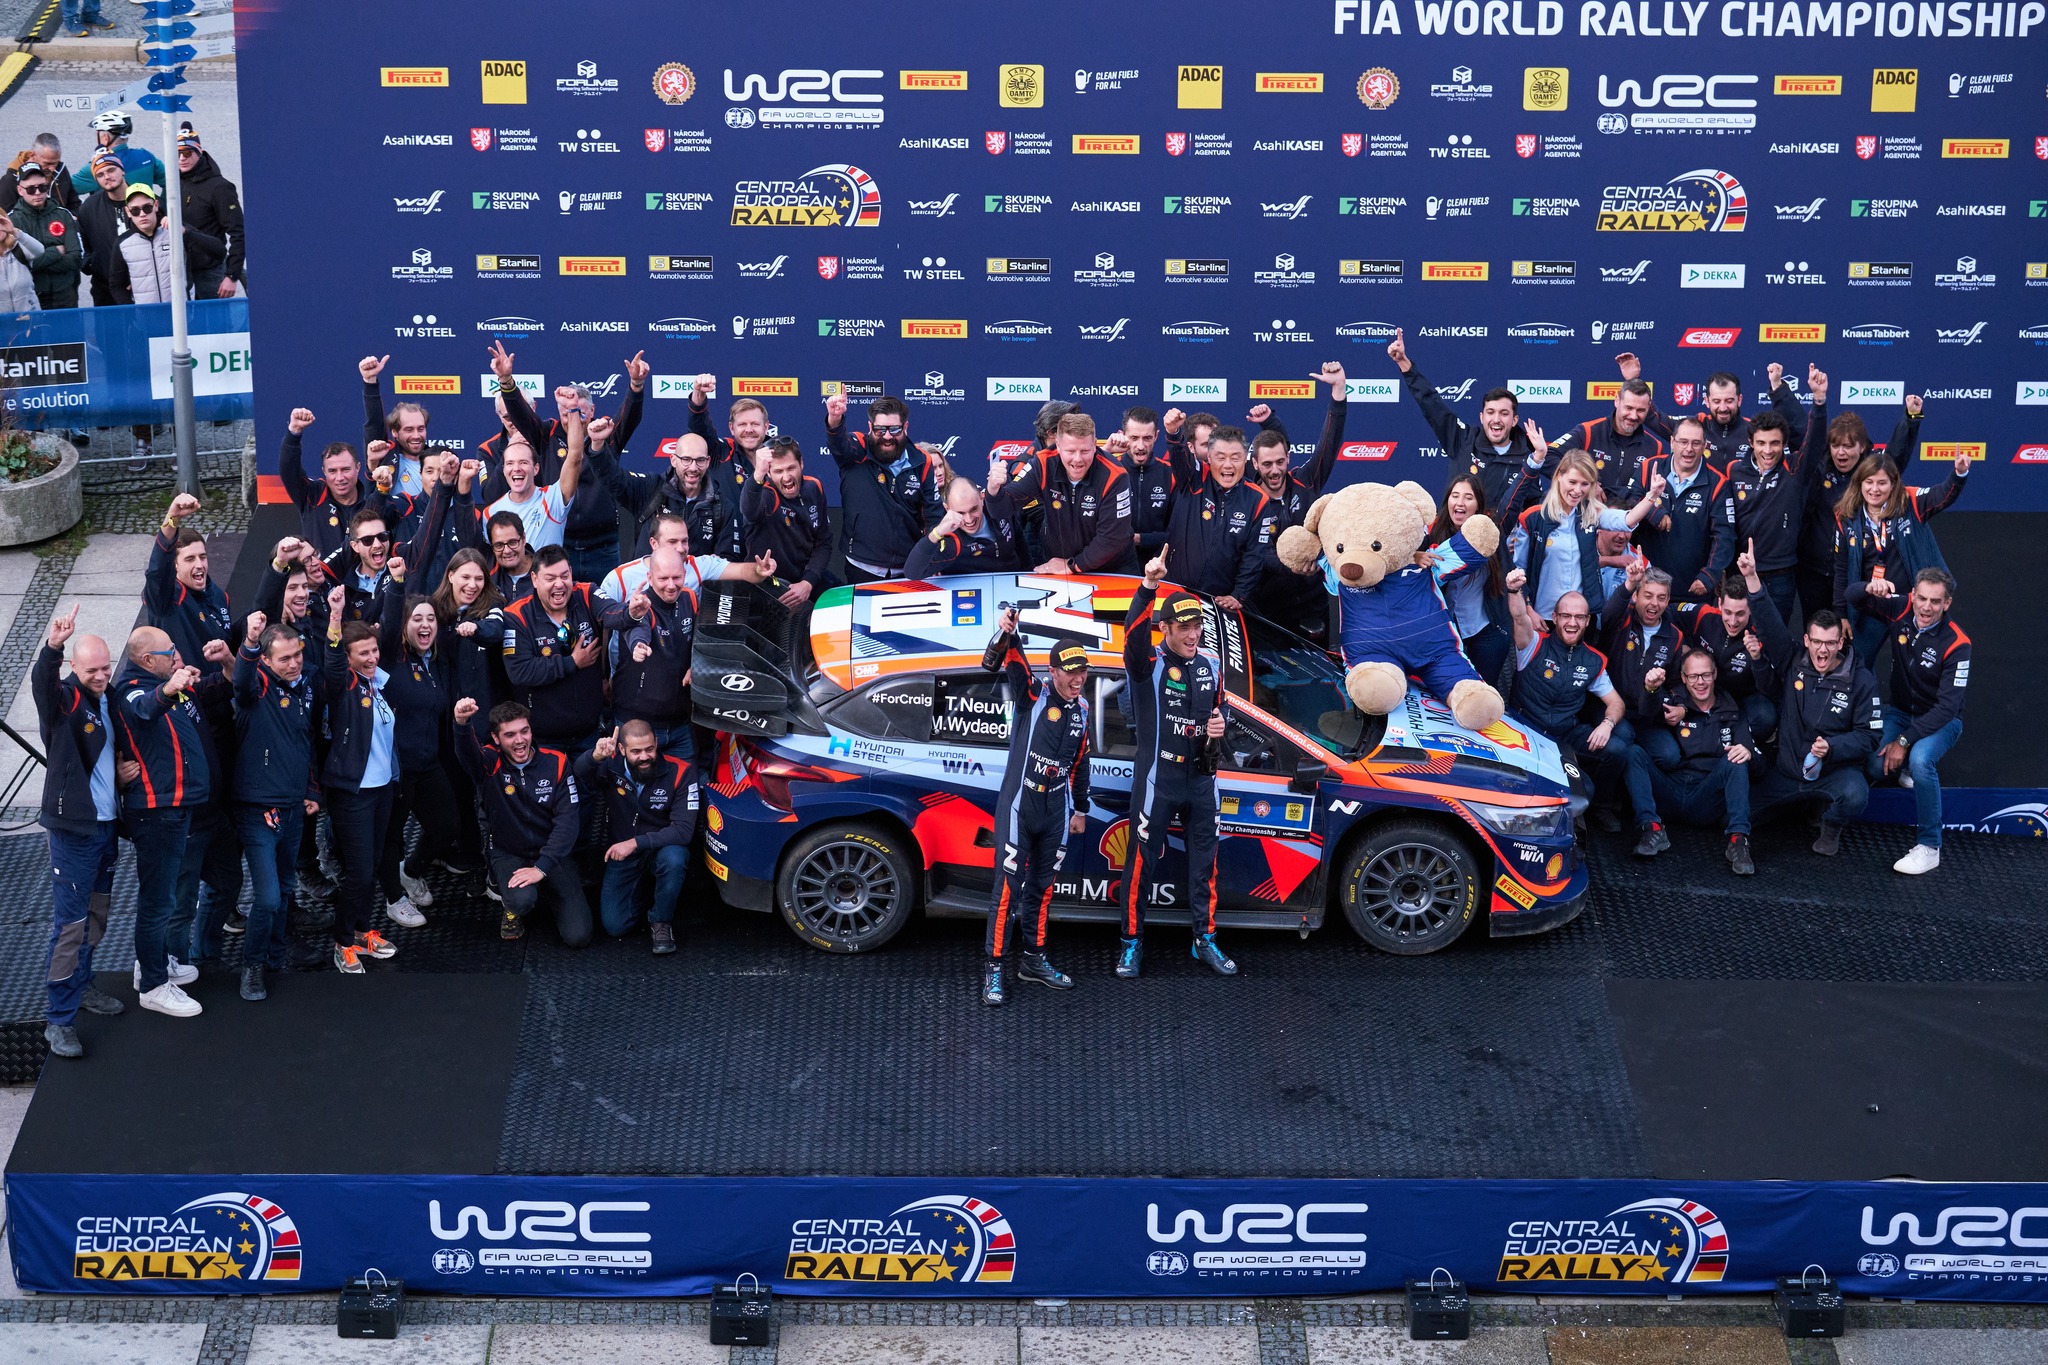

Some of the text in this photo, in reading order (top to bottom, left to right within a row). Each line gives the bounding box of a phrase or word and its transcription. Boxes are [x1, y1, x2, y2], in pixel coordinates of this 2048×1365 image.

[1334, 0, 2046, 38] FIA WORLD RALLY CHAMPIONSHIP
[484, 63, 523, 76] ADAC
[1181, 68, 1220, 81] ADAC
[388, 71, 442, 83] PIRELLI
[907, 74, 961, 86] PIRELLI
[1096, 70, 1138, 82] CLEAN FUELS
[1875, 71, 1917, 86] ADAC
[557, 79, 618, 88] FORUM8
[724, 69, 884, 102] WRC
[1095, 81, 1121, 90] FOR ALL
[1263, 77, 1317, 88] PIRELLI
[1781, 79, 1836, 91] PIRELLI
[1598, 75, 1758, 107] WRC
[53, 98, 73, 108] WC
[558, 143, 620, 152] TW STEEL
[1079, 139, 1133, 150] PIRELLI
[1949, 143, 2003, 154] PIRELLI
[1429, 148, 1490, 158] TW STEEL
[736, 181, 819, 193] CENTRAL
[1603, 187, 1686, 198] CENTRAL
[493, 192, 540, 202] SKUPINA
[734, 195, 836, 208] EUROPEAN
[1184, 197, 1231, 205] SKUPINA
[1600, 200, 1703, 213] EUROPEAN
[1871, 200, 1918, 210] SKUPINA
[732, 209, 824, 224] RALLY
[1598, 214, 1691, 230] RALLY
[500, 259, 537, 268] Starline
[392, 265, 453, 275] FORUM8
[1429, 266, 1482, 277] PIRELLI
[1704, 271, 1737, 279] DEKRA
[1871, 266, 1909, 275] Starline
[1766, 275, 1826, 284] TW STEEL
[1935, 275, 1995, 283] FORUM8
[477, 322, 544, 330] KnausTabbert
[908, 323, 961, 334] PIRELLI
[1843, 328, 1909, 338] KnausTabbert
[0, 355, 79, 378] tarline
[210, 350, 252, 374] DEK
[401, 379, 454, 390] PIRELLI
[739, 381, 792, 392] PIRELLI
[1009, 385, 1042, 393] DEKRA
[1186, 385, 1219, 393] DEKRA
[1256, 384, 1309, 395] PIRELLI
[1530, 387, 1562, 395] DEKRA
[1863, 388, 1896, 396] DEKRA
[23, 392, 90, 410] solution
[716, 594, 733, 625] HYUNDAI
[1222, 612, 1244, 673] FANATEC
[854, 664, 880, 676] OMP
[872, 693, 932, 706] #ForCraig
[945, 696, 1013, 716] T.Neuvil
[1166, 714, 1195, 725] HYUNDAI
[1227, 694, 1325, 758] motorsport.hyundai.com
[1235, 721, 1265, 744] HYUNDAI
[854, 740, 904, 756] HYUNDAI
[852, 750, 888, 764] STEEL
[928, 751, 966, 759] HYUNDAI
[1030, 751, 1060, 766] HYUNDAI
[942, 758, 986, 776] WIA
[1090, 764, 1133, 778] INNOC
[1235, 826, 1276, 836] Championship
[854, 835, 890, 853] ZERO
[1513, 842, 1538, 851] HYUNDAI
[1520, 850, 1544, 863] WIA
[1081, 878, 1176, 905] MOIS
[1499, 878, 1532, 906] PIRELLI
[77, 1217, 205, 1233] CENTRAL
[429, 1200, 651, 1242] WRC
[1147, 1203, 1368, 1243] WRC
[793, 1219, 921, 1236] CENTRAL
[1508, 1221, 1635, 1237] CENTRAL
[76, 1236, 232, 1255] EUROPEAN
[789, 1238, 947, 1256] EUROPEAN
[1503, 1239, 1661, 1258] EUROPEAN
[484, 1253, 648, 1265] FIA WORLD RALLY
[1198, 1254, 1362, 1265] FIA WORLD RALLY
[74, 1255, 220, 1277] RALLY
[485, 1266, 649, 1275] CHAMPIONSHIP
[786, 1258, 928, 1279] RALLY
[1499, 1259, 1643, 1279] RALLY
